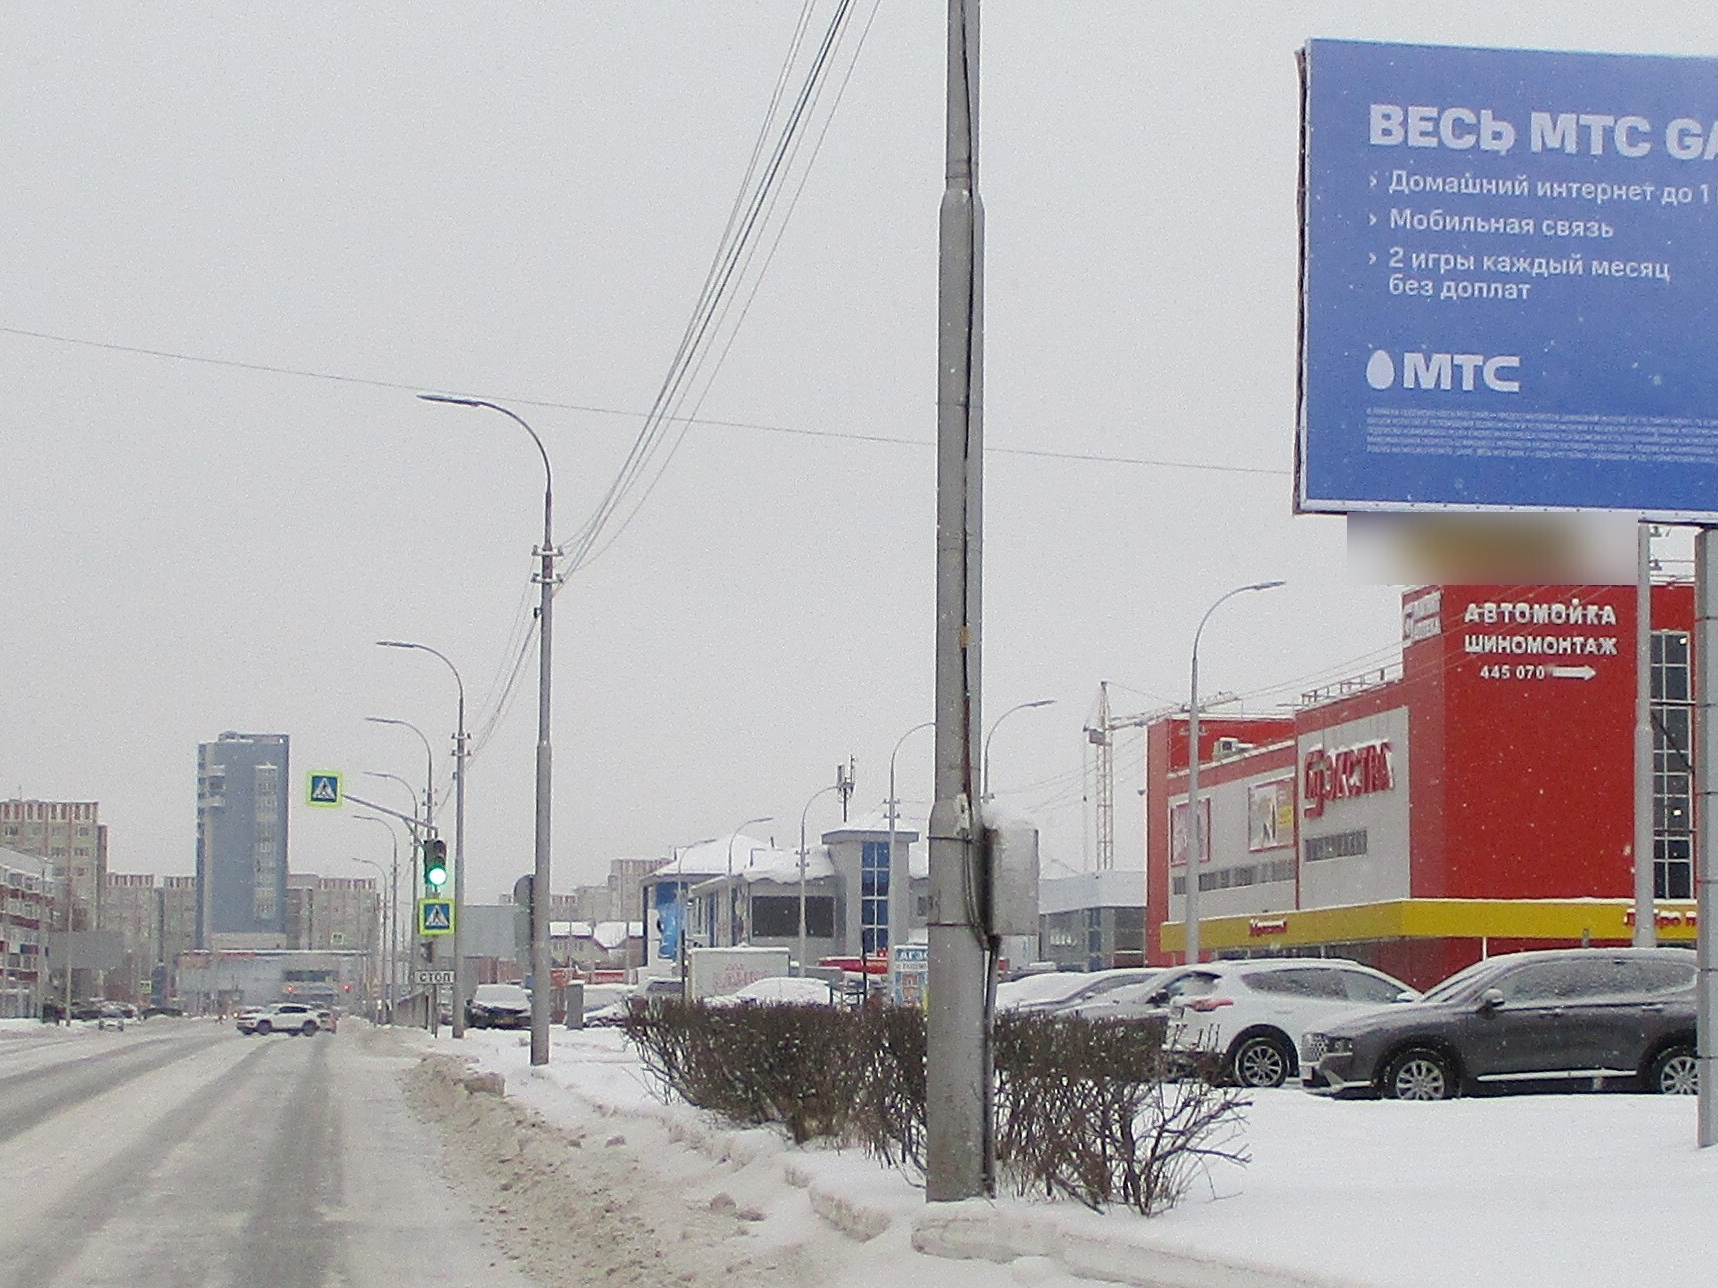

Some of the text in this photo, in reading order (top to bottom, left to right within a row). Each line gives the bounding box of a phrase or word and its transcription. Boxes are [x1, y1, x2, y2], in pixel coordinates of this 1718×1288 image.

[1369, 104, 1516, 155] ВЕСЬ
[1530, 112, 1652, 158] МТС
[1389, 169, 1529, 197] Домашний
[1537, 182, 1655, 204] интернет
[1660, 185, 1693, 206] до
[1700, 184, 1710, 204] 1
[1389, 208, 1614, 238] Мобильная связь
[1388, 247, 1671, 285] 2 игры каждый месяц
[1388, 274, 1531, 300] без доплат
[1402, 352, 1521, 393] МТС
[1464, 598, 1617, 626] АВТОМОЙКА
[1464, 634, 1618, 655] ШИНОМОНТАЖ
[1479, 665, 1546, 680] 445 070
